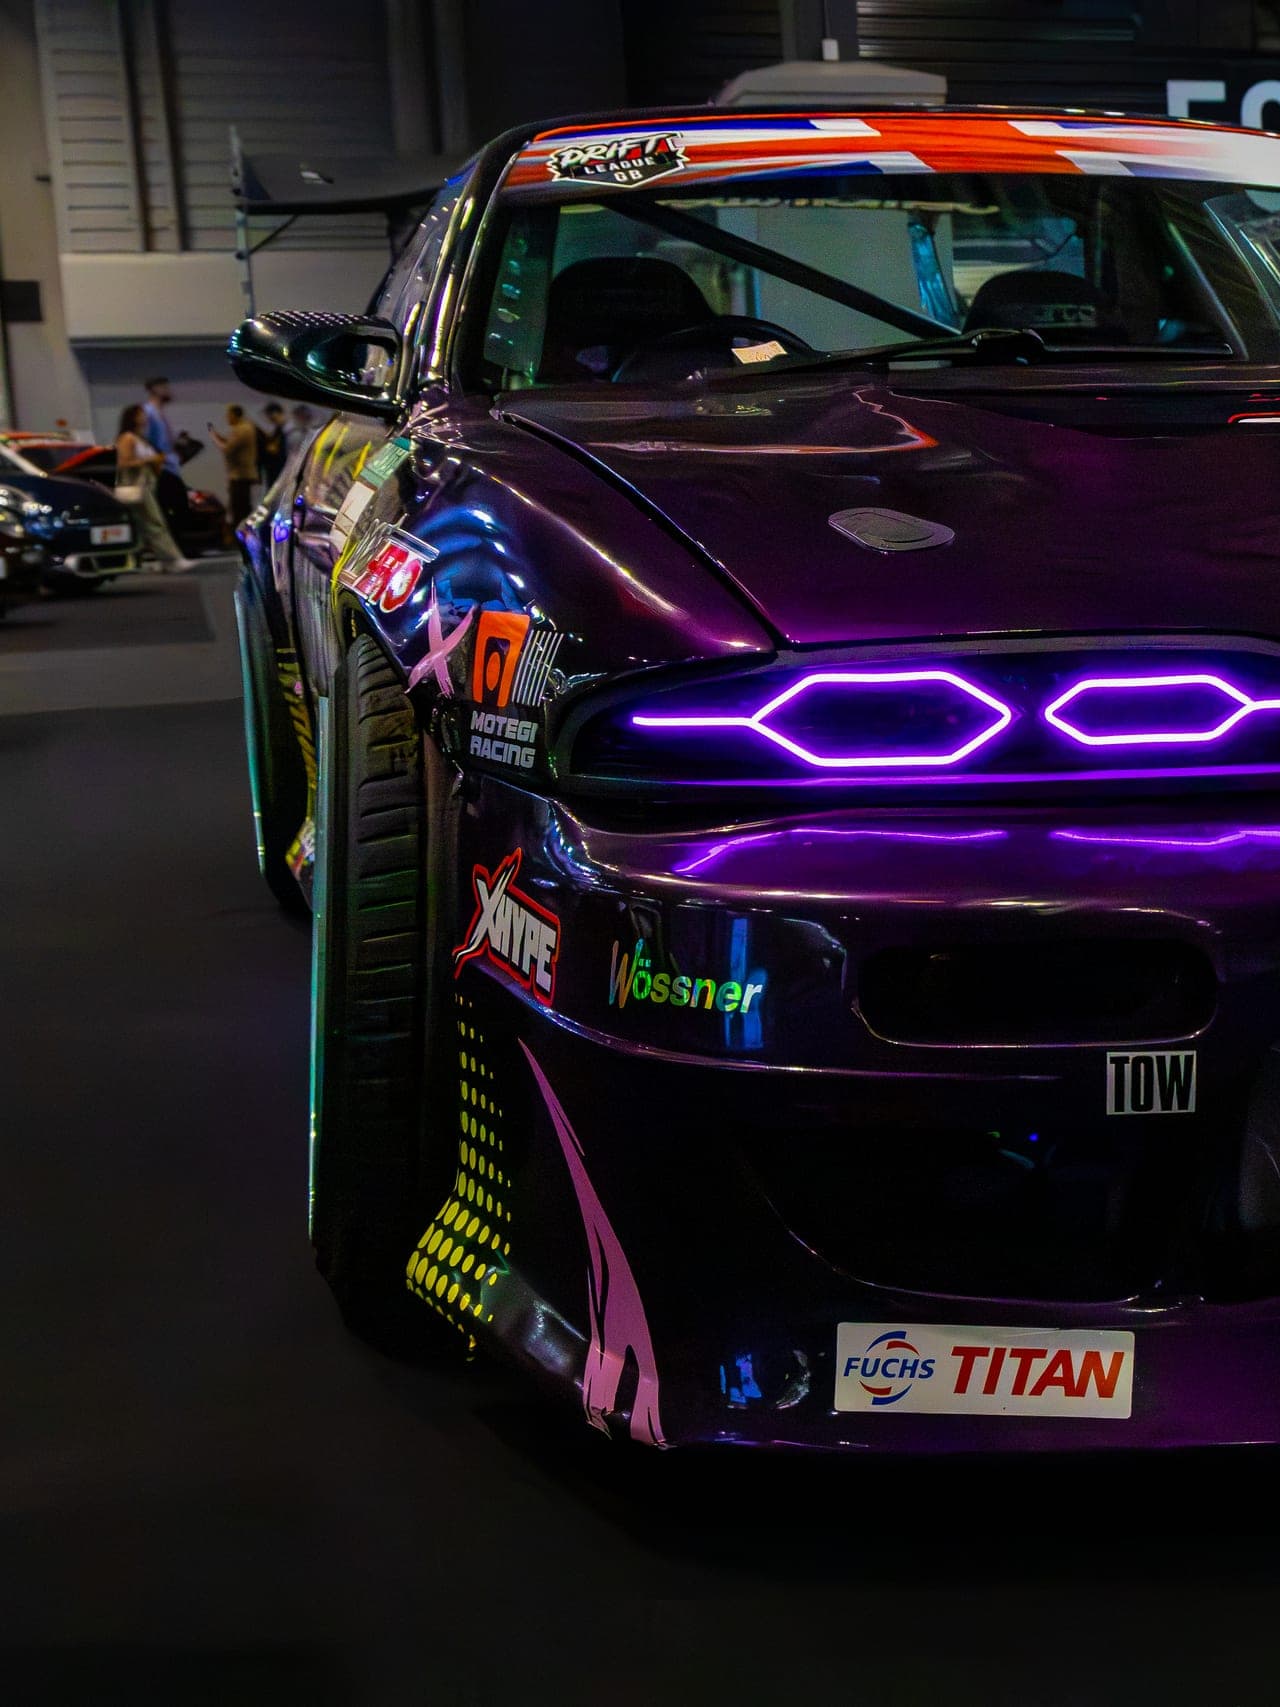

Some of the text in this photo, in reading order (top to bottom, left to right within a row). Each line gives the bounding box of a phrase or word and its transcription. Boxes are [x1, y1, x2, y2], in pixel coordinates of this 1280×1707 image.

[560, 131, 684, 168] DRIFT
[584, 156, 657, 175] LEAGUE
[614, 169, 644, 183] GB
[470, 710, 539, 744] MOTEGI
[470, 735, 537, 769] RACING
[454, 864, 557, 994] XHYPE
[608, 936, 764, 1014] Wössner
[1109, 1054, 1195, 1113] TOW
[843, 1346, 1125, 1399] FUCHS TITAN
